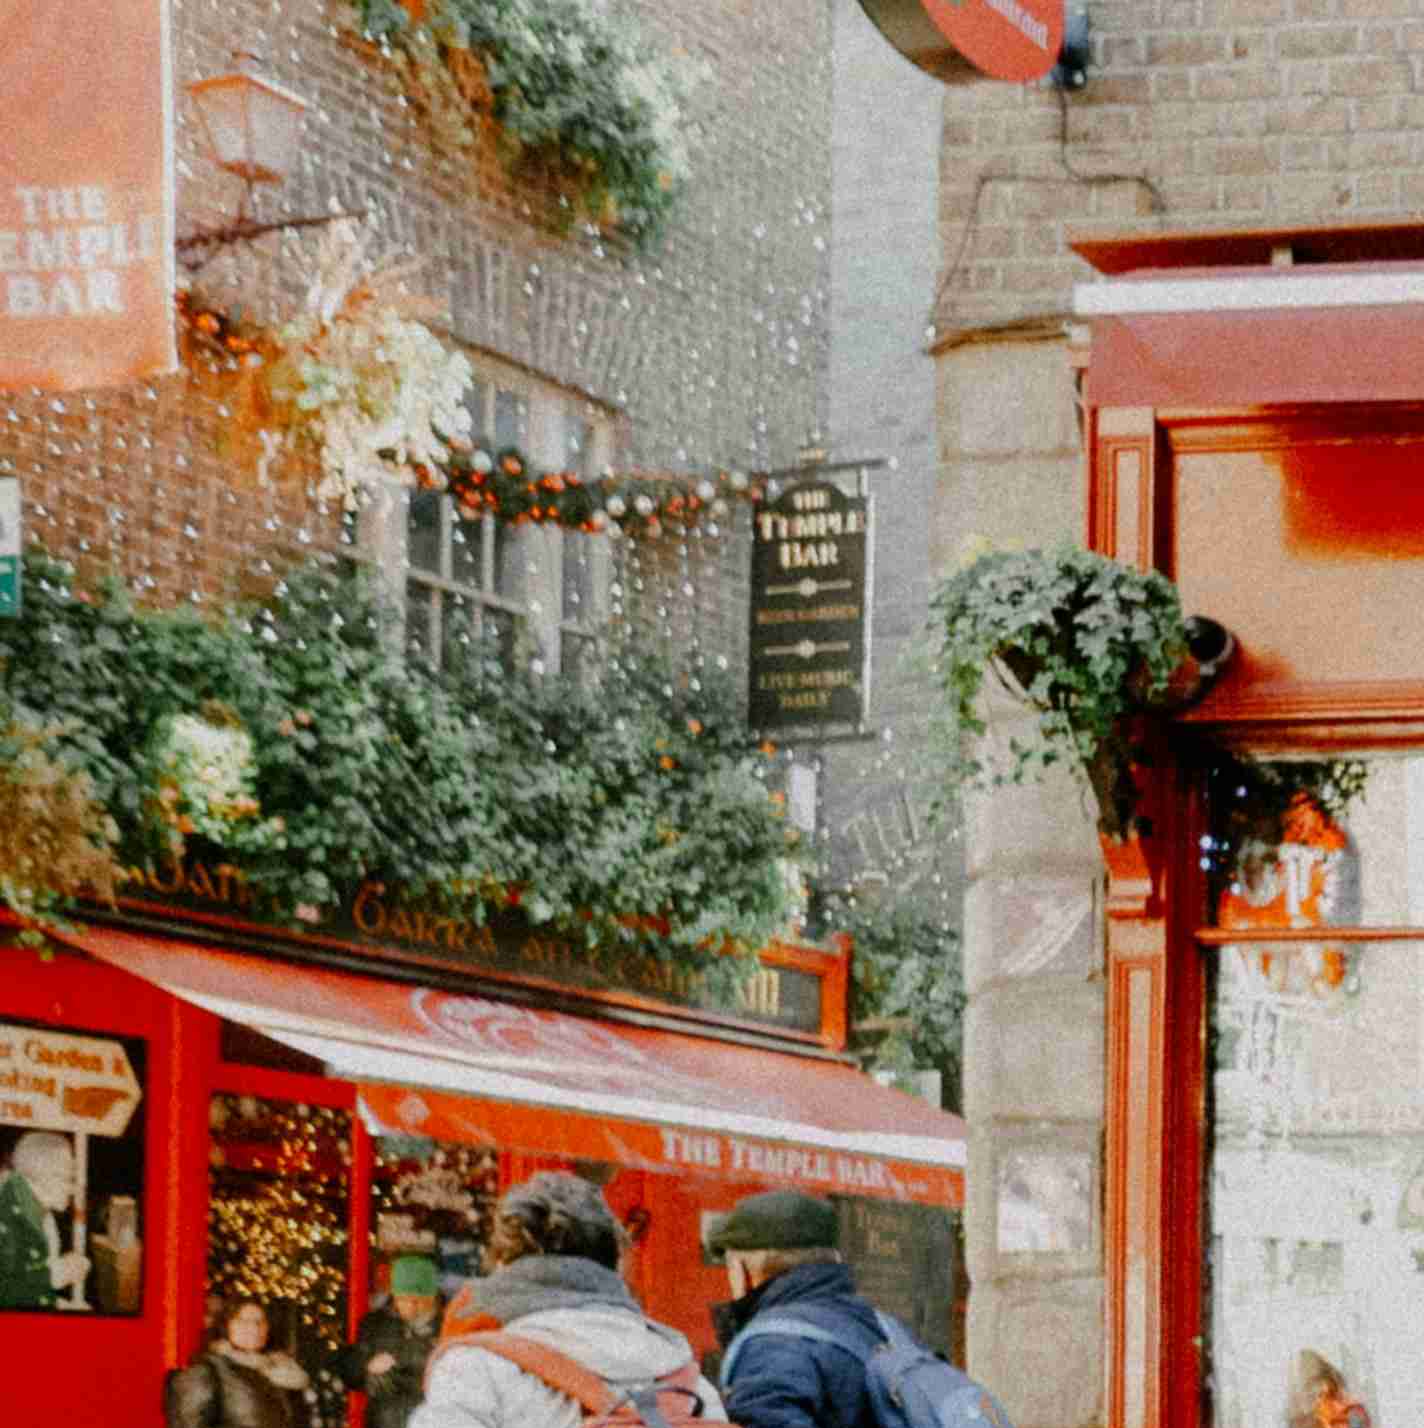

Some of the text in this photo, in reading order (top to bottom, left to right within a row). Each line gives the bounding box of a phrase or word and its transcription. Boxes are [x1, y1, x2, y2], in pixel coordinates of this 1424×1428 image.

[15, 185, 107, 225] THE
[0, 224, 160, 268] EMPLE
[8, 270, 127, 318] BAR
